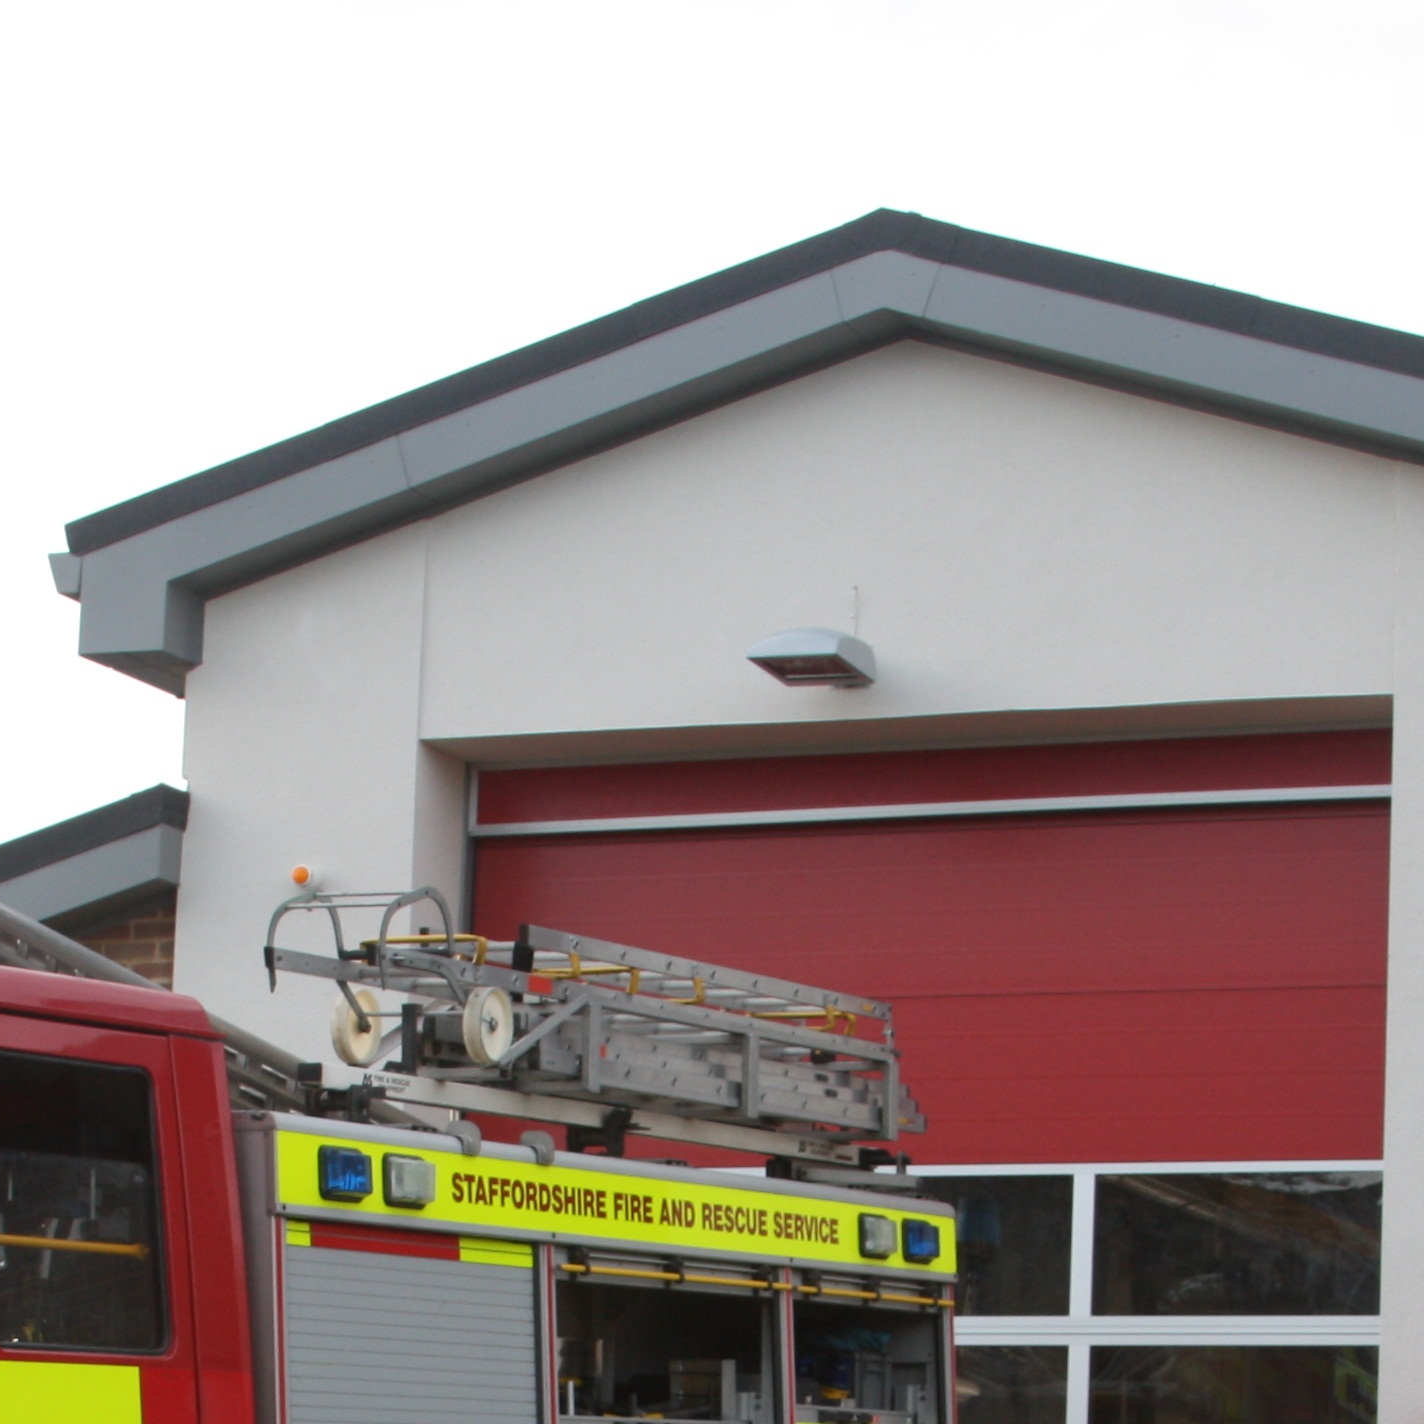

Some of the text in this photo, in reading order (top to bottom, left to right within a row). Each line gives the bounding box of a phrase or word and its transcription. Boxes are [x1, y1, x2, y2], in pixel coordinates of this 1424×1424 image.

[451, 1172, 839, 1245] STAFFORDSHIRE FIRE AND RESCUE SERVICE
